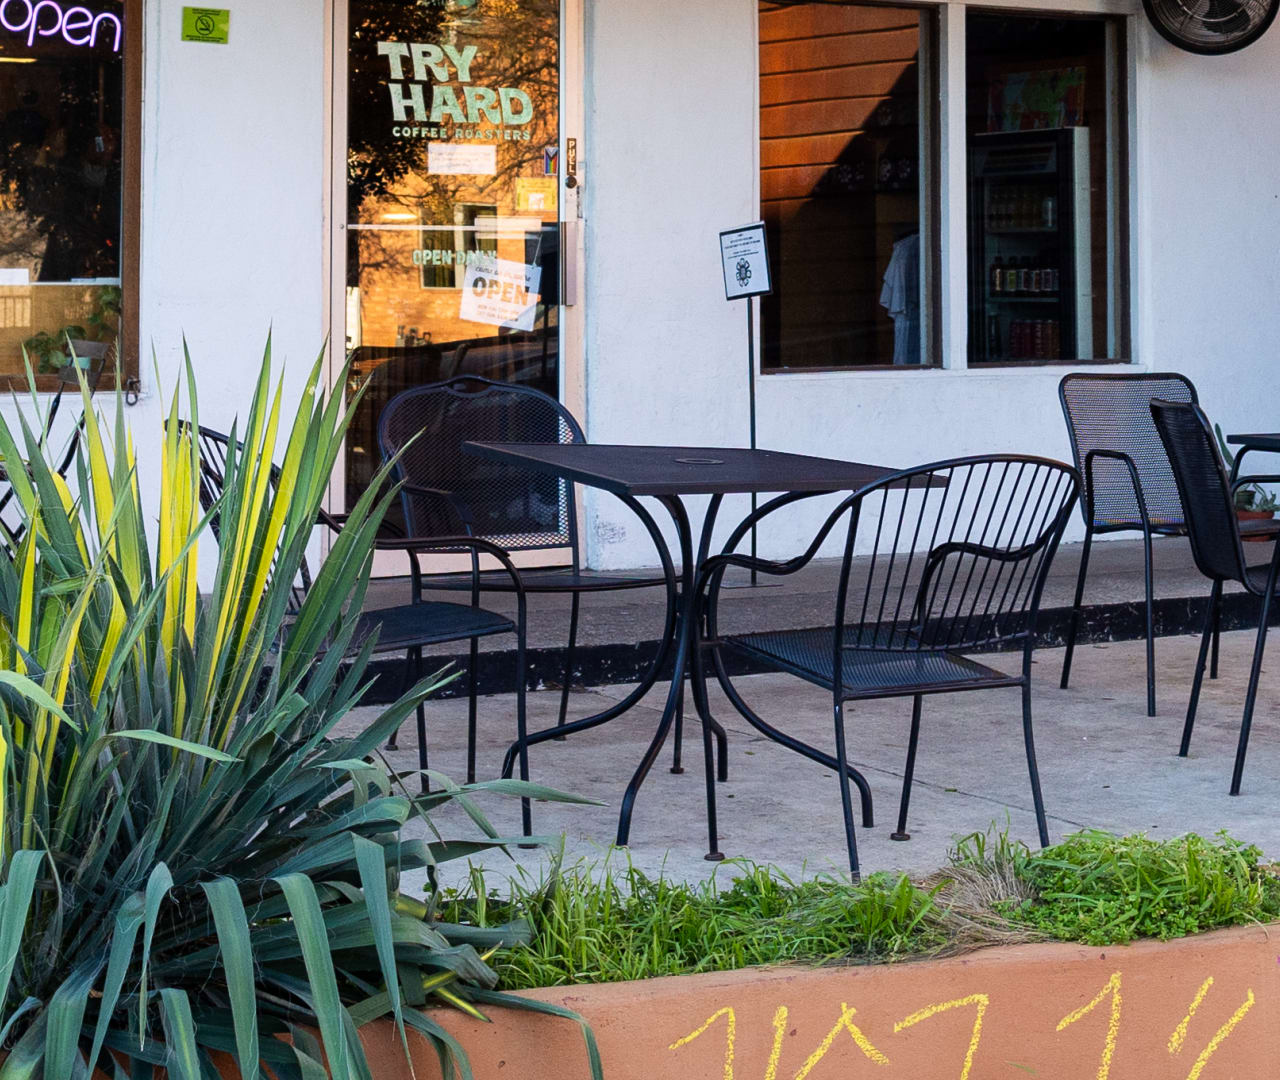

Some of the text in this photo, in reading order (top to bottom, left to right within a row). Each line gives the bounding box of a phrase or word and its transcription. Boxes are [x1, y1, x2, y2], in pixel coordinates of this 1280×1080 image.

[377, 40, 478, 83] TRY
[388, 83, 534, 126] HARD
[392, 126, 531, 141] COFFEE ROASTERS
[412, 249, 452, 265] OPEN
[471, 276, 530, 306] OPEN
